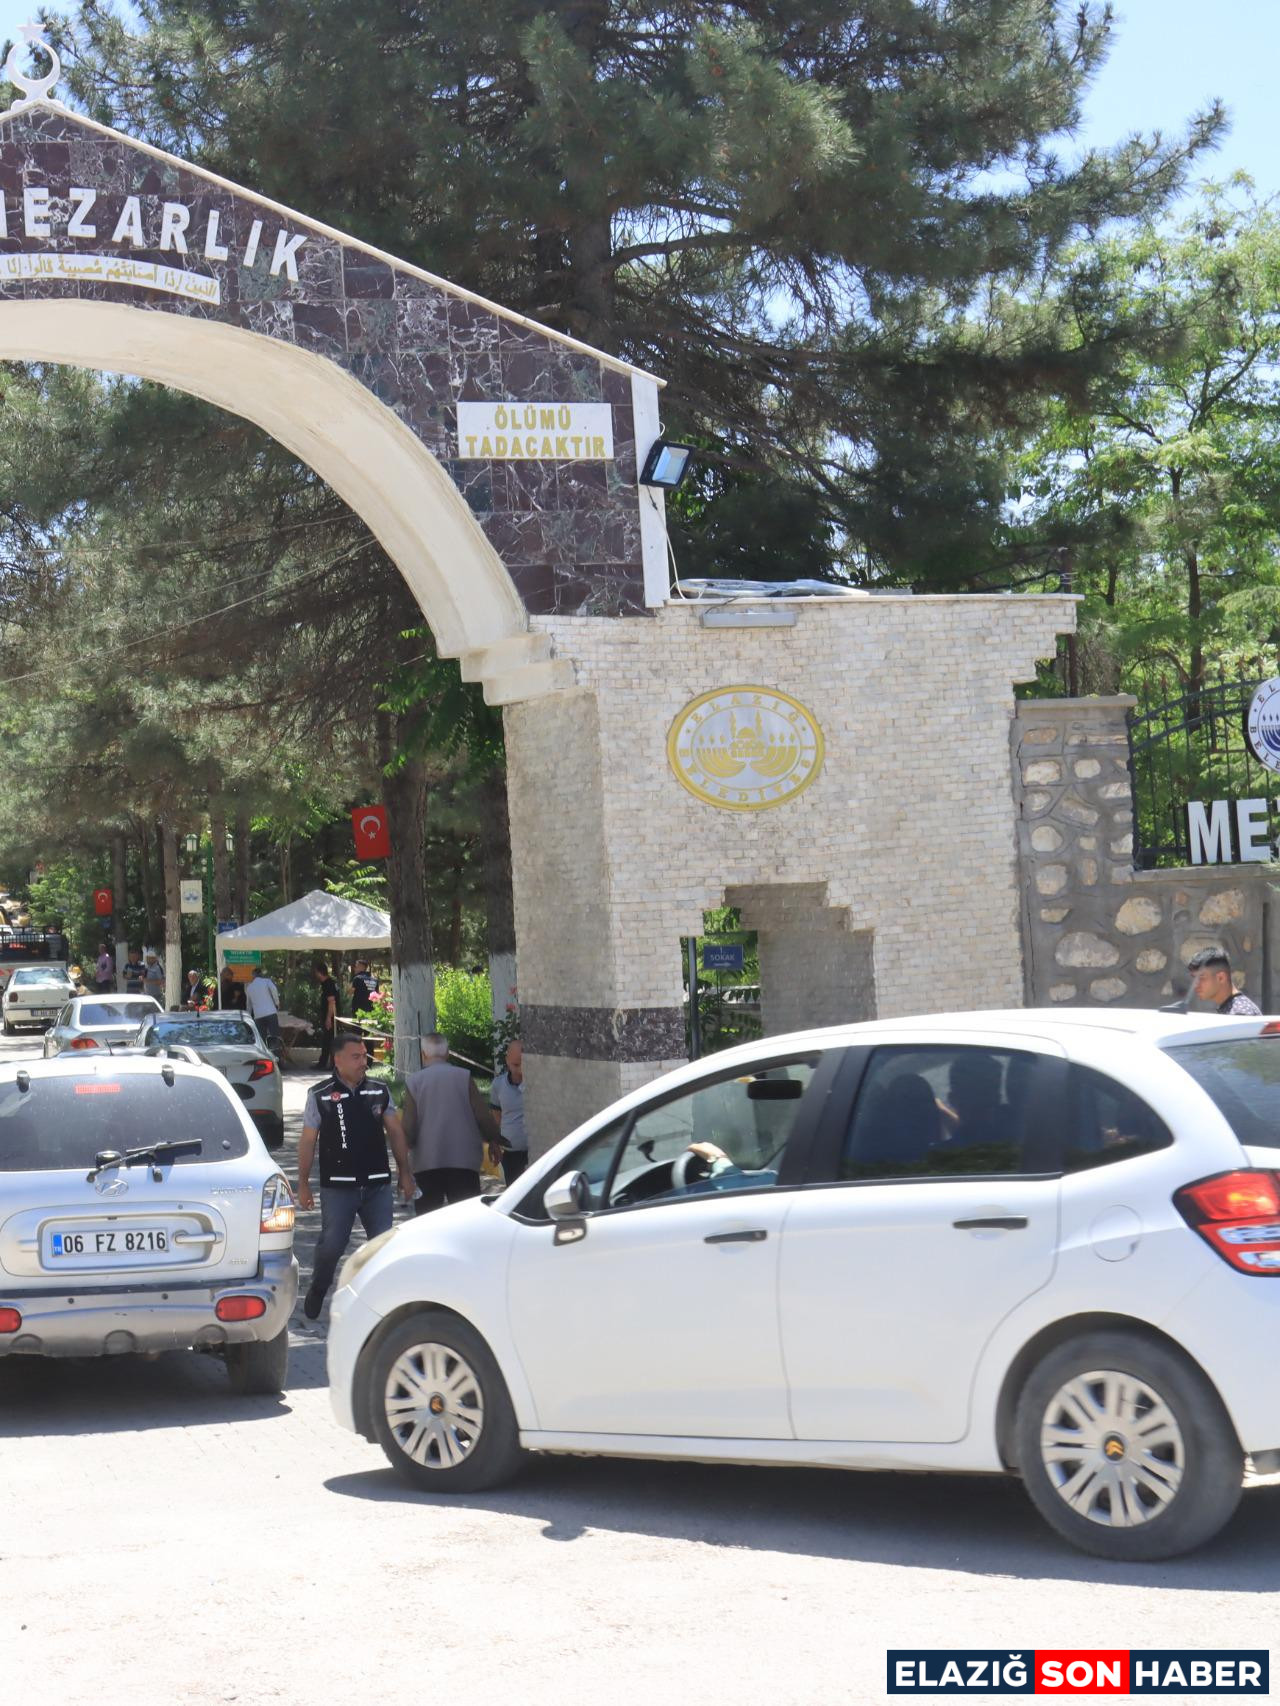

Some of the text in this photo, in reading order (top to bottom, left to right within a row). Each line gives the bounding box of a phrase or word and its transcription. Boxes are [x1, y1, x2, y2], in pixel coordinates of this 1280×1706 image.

[494, 405, 571, 430] ÖLÜMÜ
[465, 435, 606, 458] TADACAKTIR
[1187, 798, 1280, 866] ME
[63, 1231, 166, 1253] 06 FZ 8216
